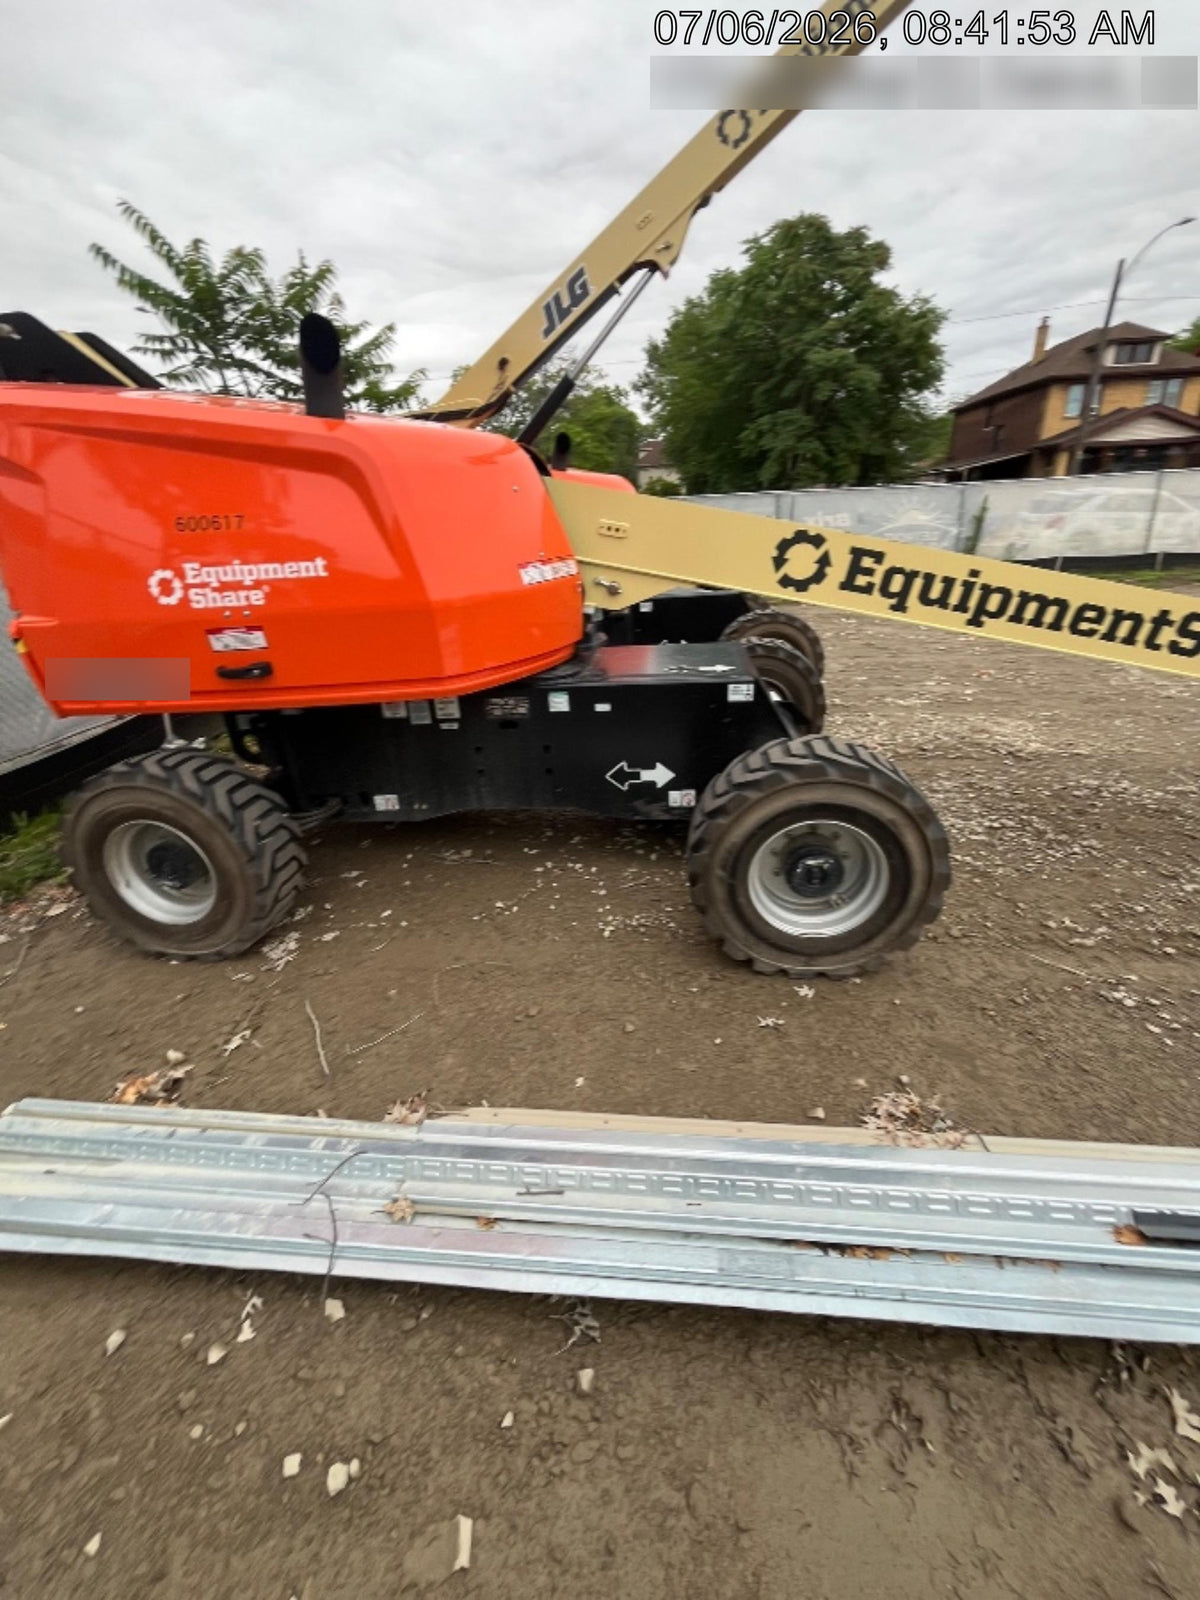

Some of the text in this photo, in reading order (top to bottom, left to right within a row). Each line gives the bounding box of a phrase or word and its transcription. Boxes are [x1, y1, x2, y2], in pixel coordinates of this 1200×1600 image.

[543, 266, 590, 338] JLG
[175, 515, 246, 532] 600617
[182, 557, 329, 586] Equipment
